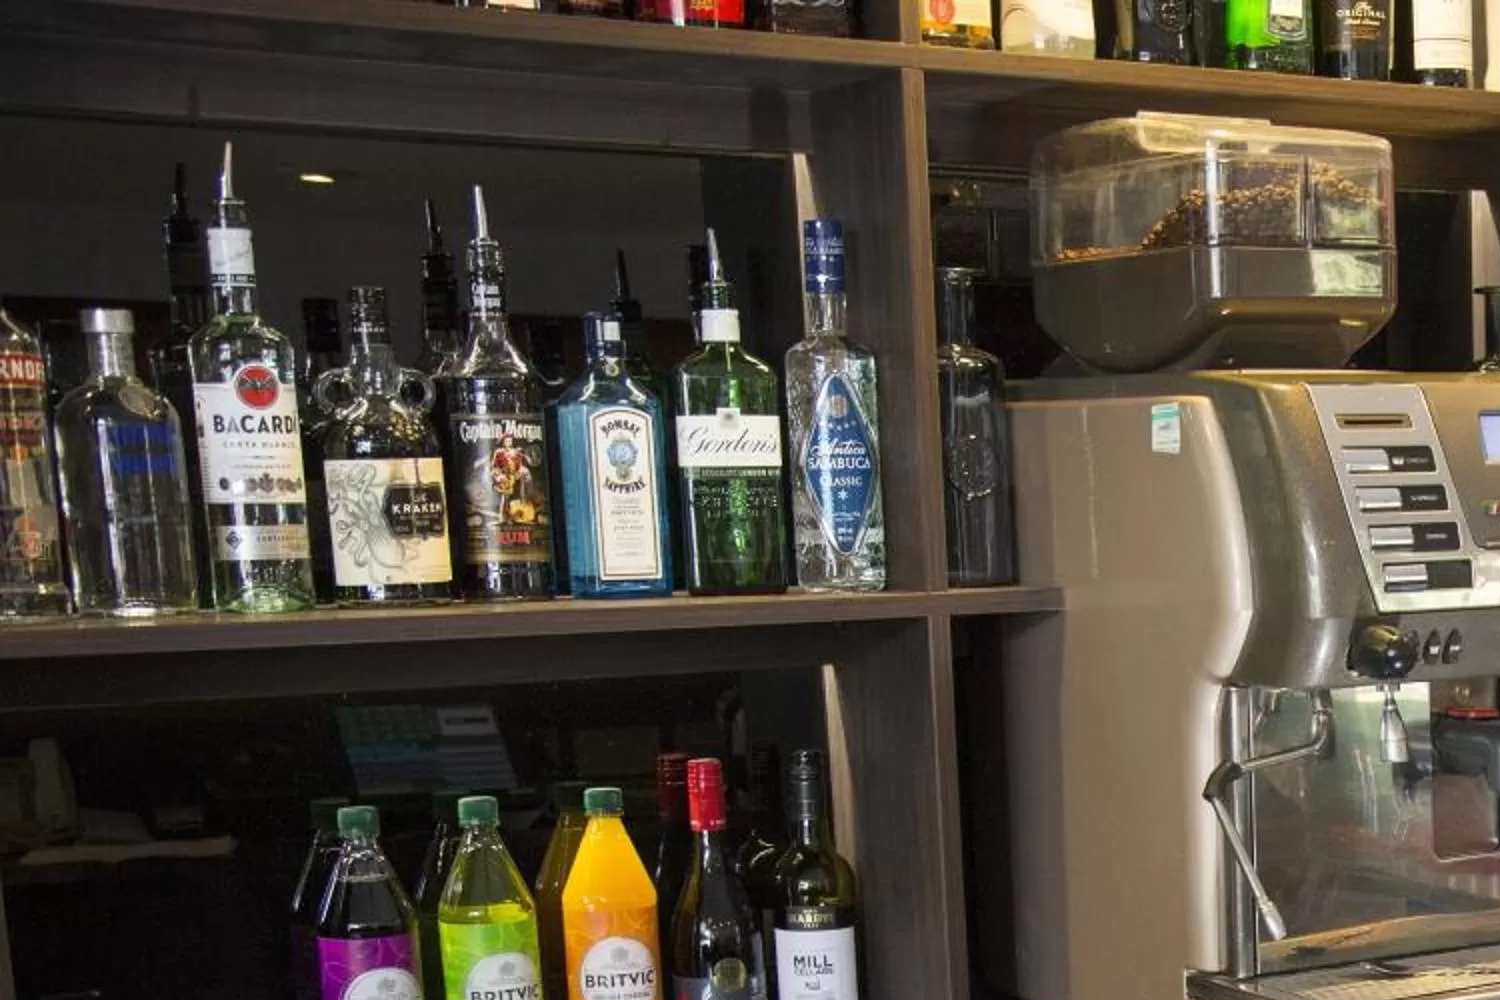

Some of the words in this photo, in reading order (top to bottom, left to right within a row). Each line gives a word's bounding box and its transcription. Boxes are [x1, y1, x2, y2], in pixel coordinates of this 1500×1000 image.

[460, 420, 501, 443] Captain
[502, 419, 543, 441] Morgan
[601, 419, 641, 438] BOMBAY
[687, 425, 777, 456] Gordon's
[807, 456, 870, 470] SAMBUCA
[391, 503, 442, 515] KRAKEN
[793, 954, 833, 969] MILL
[585, 969, 655, 989] BRITVIC
